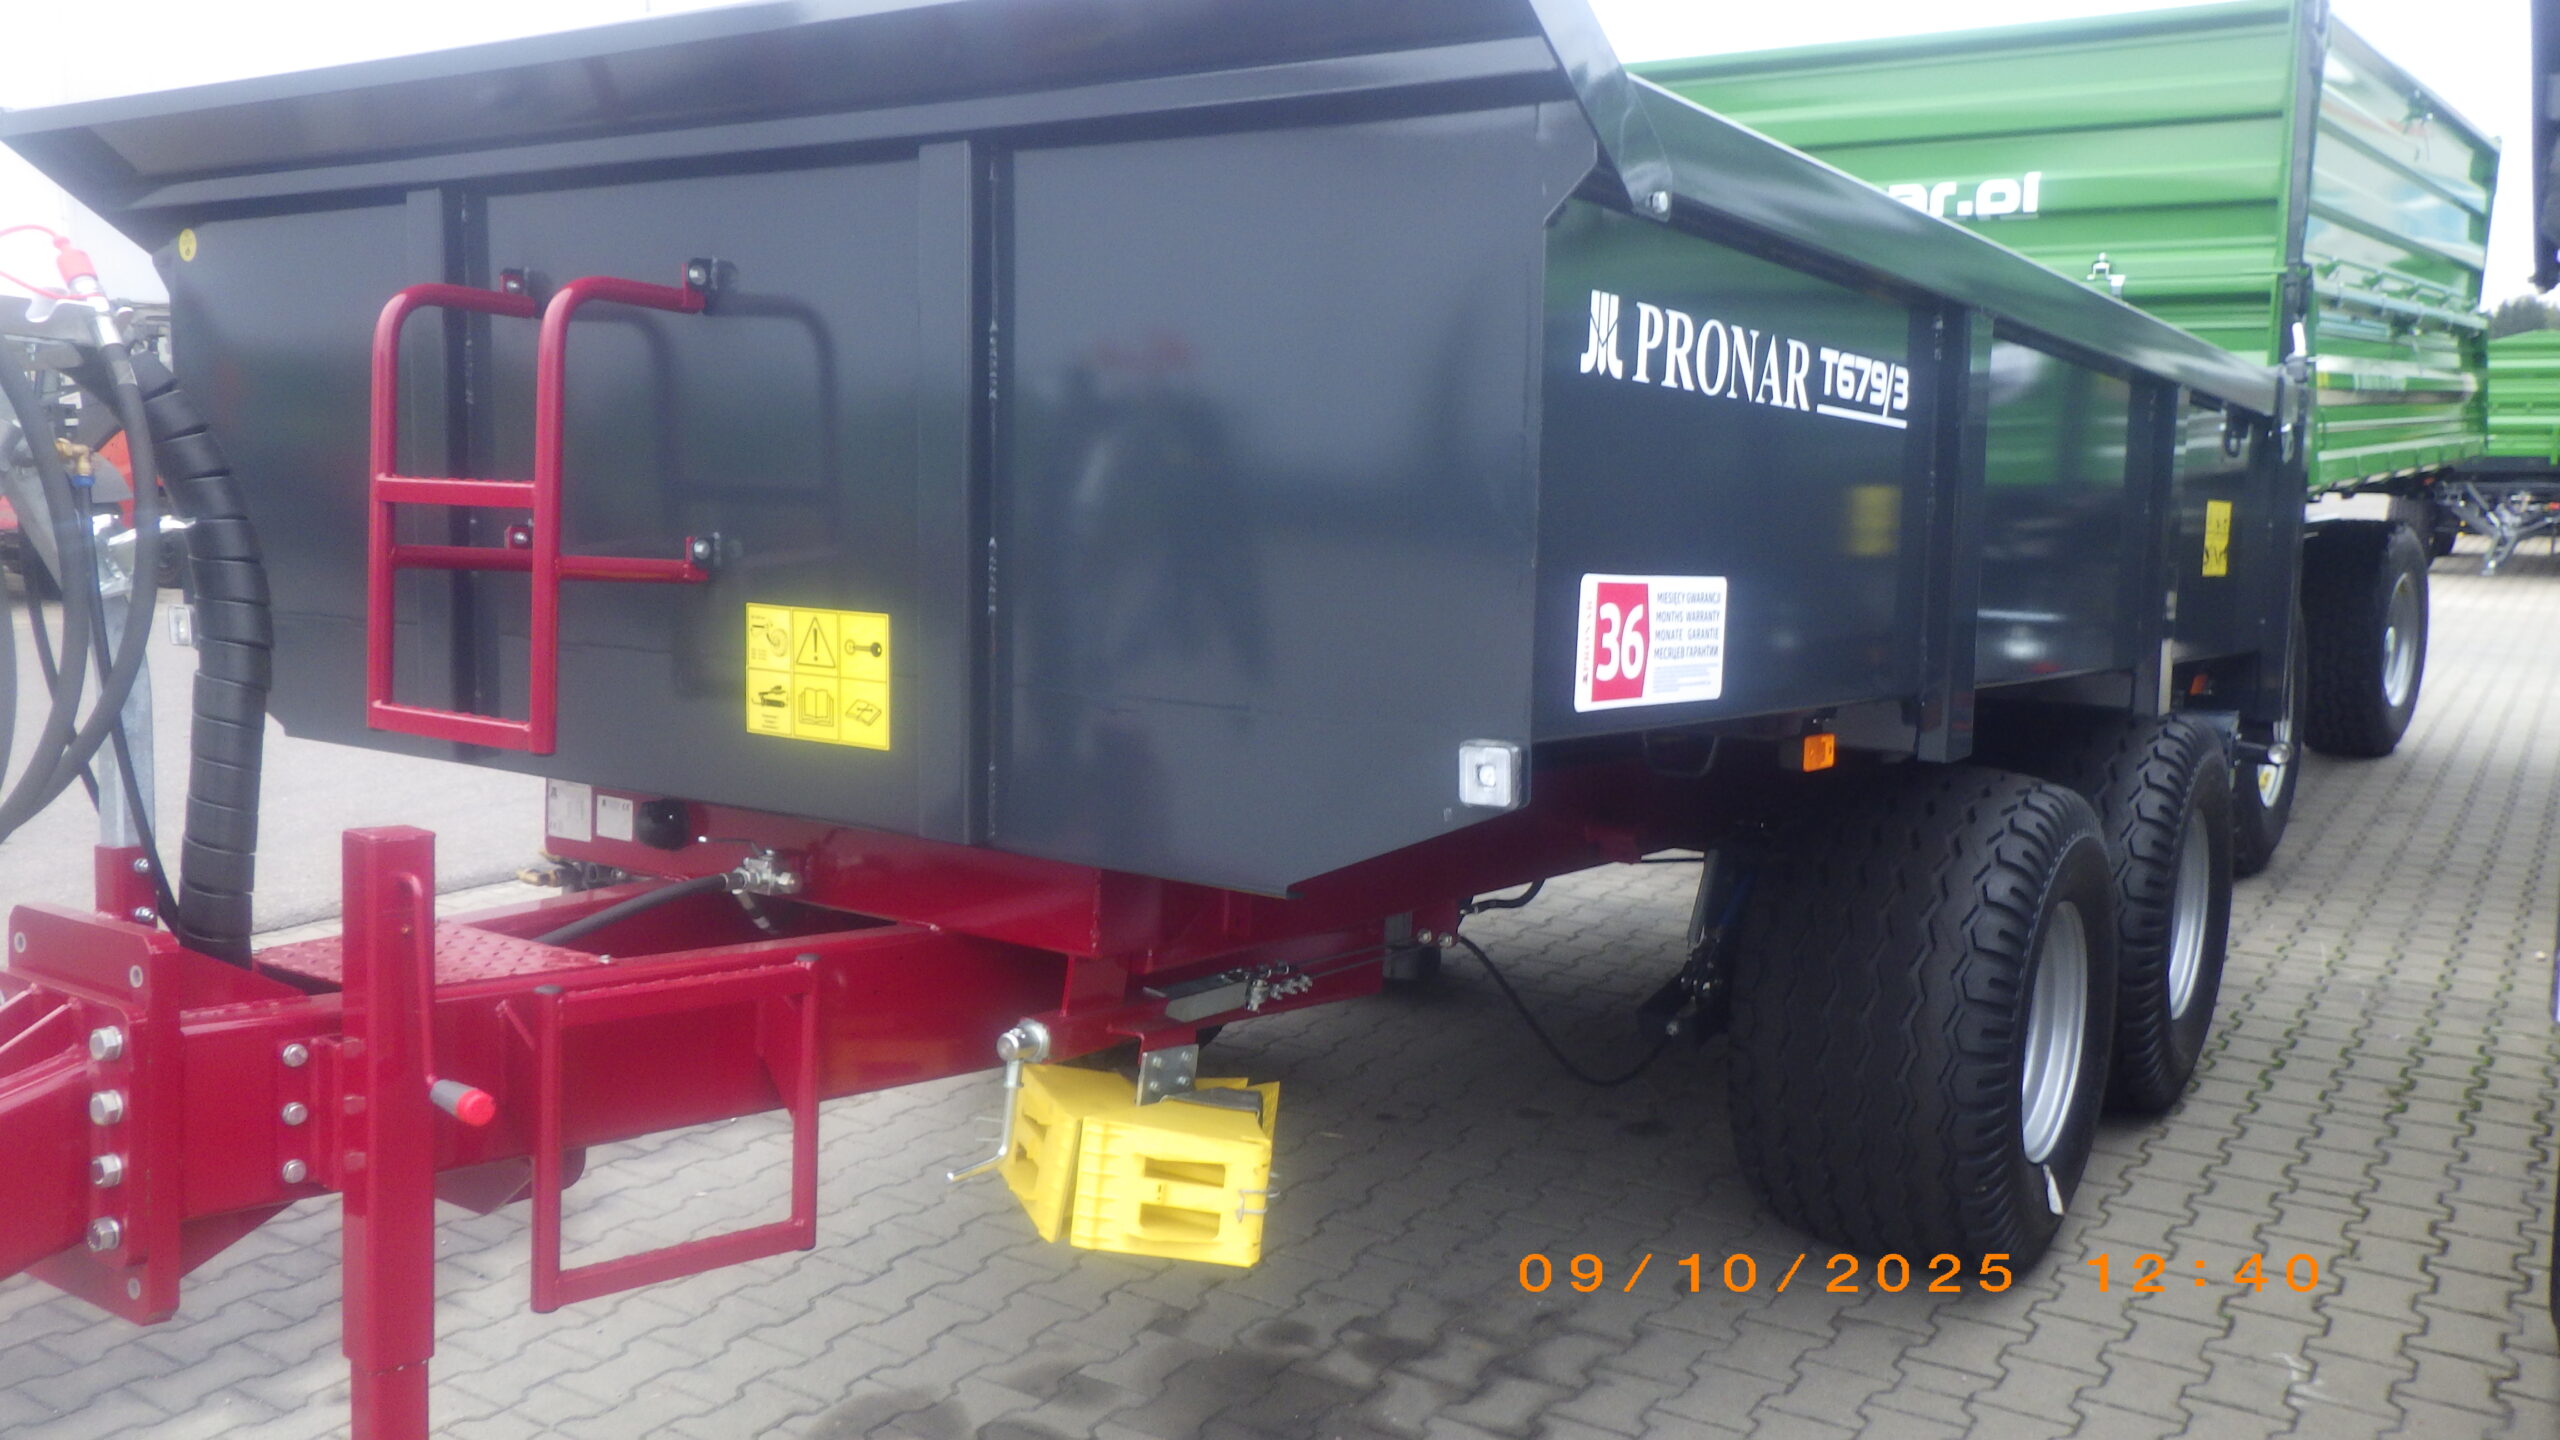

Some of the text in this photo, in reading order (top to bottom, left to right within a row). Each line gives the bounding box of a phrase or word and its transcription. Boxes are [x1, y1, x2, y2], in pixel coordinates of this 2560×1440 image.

[1632, 301, 1909, 414] PRONAR T679/3
[1655, 627, 1719, 641] MONATE GARANTIE
[1656, 610, 1720, 623] MONTHS WARRANTY
[1595, 602, 1644, 682] 36
